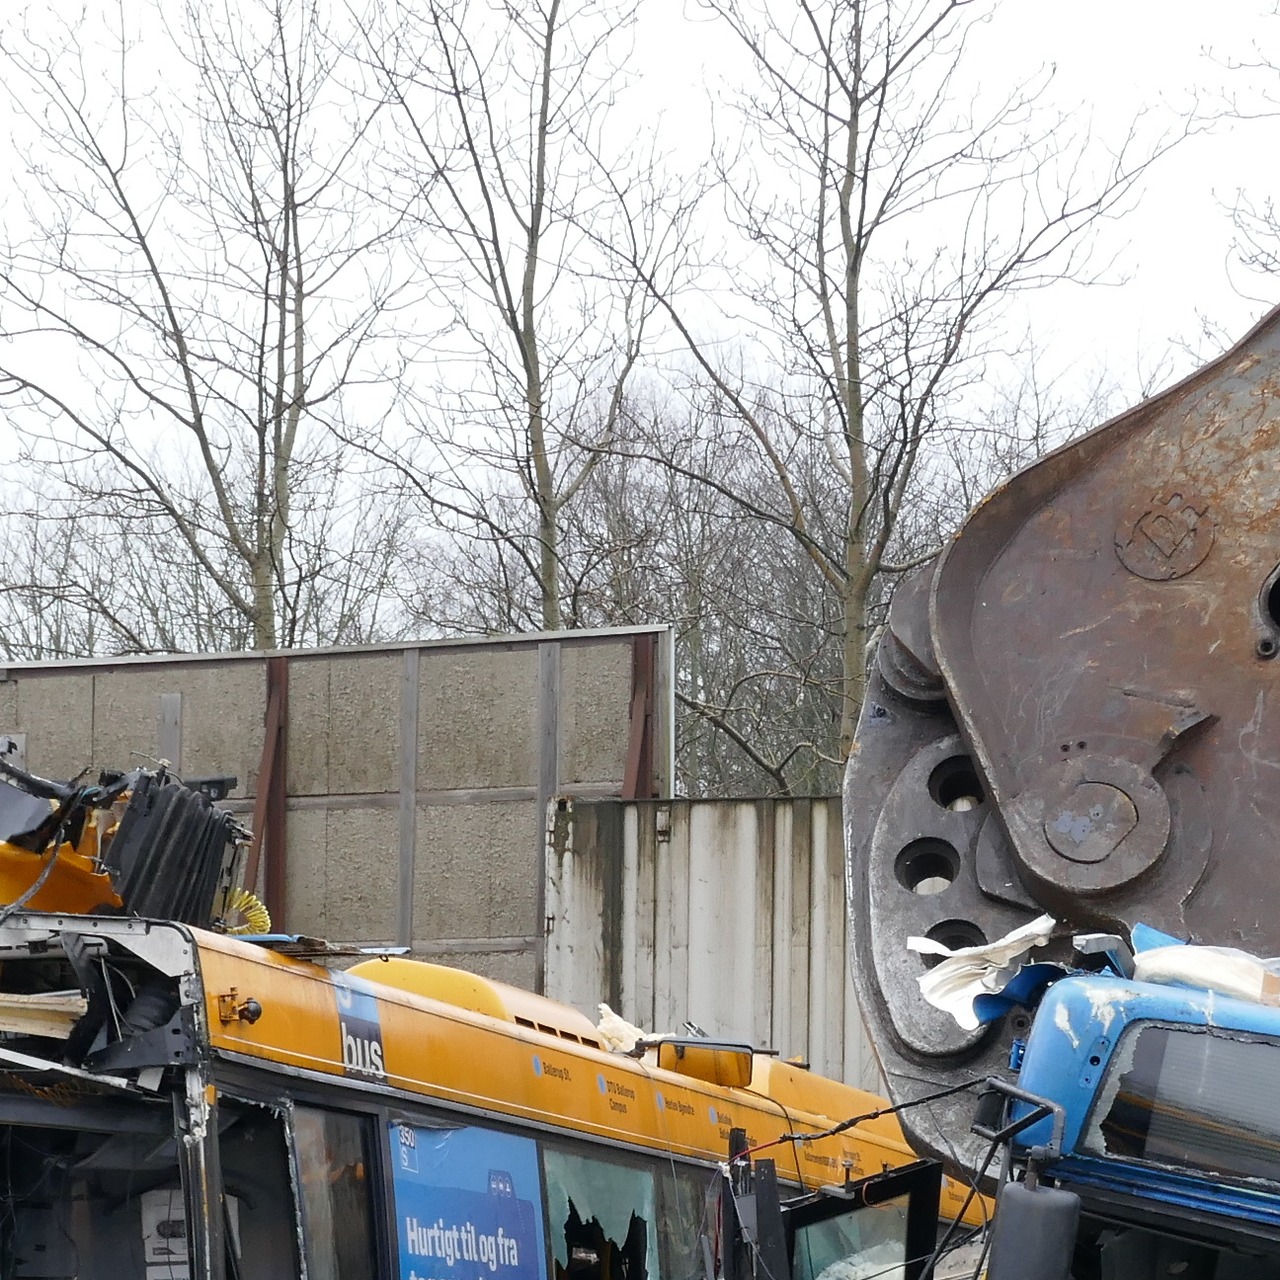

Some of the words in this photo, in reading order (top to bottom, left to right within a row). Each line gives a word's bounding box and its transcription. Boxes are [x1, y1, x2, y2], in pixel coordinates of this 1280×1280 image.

[341, 1021, 385, 1079] bus
[399, 1125, 416, 1147] 350
[401, 1148, 409, 1166] S
[406, 1217, 461, 1266] Hurtigt
[461, 1222, 478, 1262] til
[479, 1234, 497, 1271] og
[497, 1227, 518, 1266] fra
